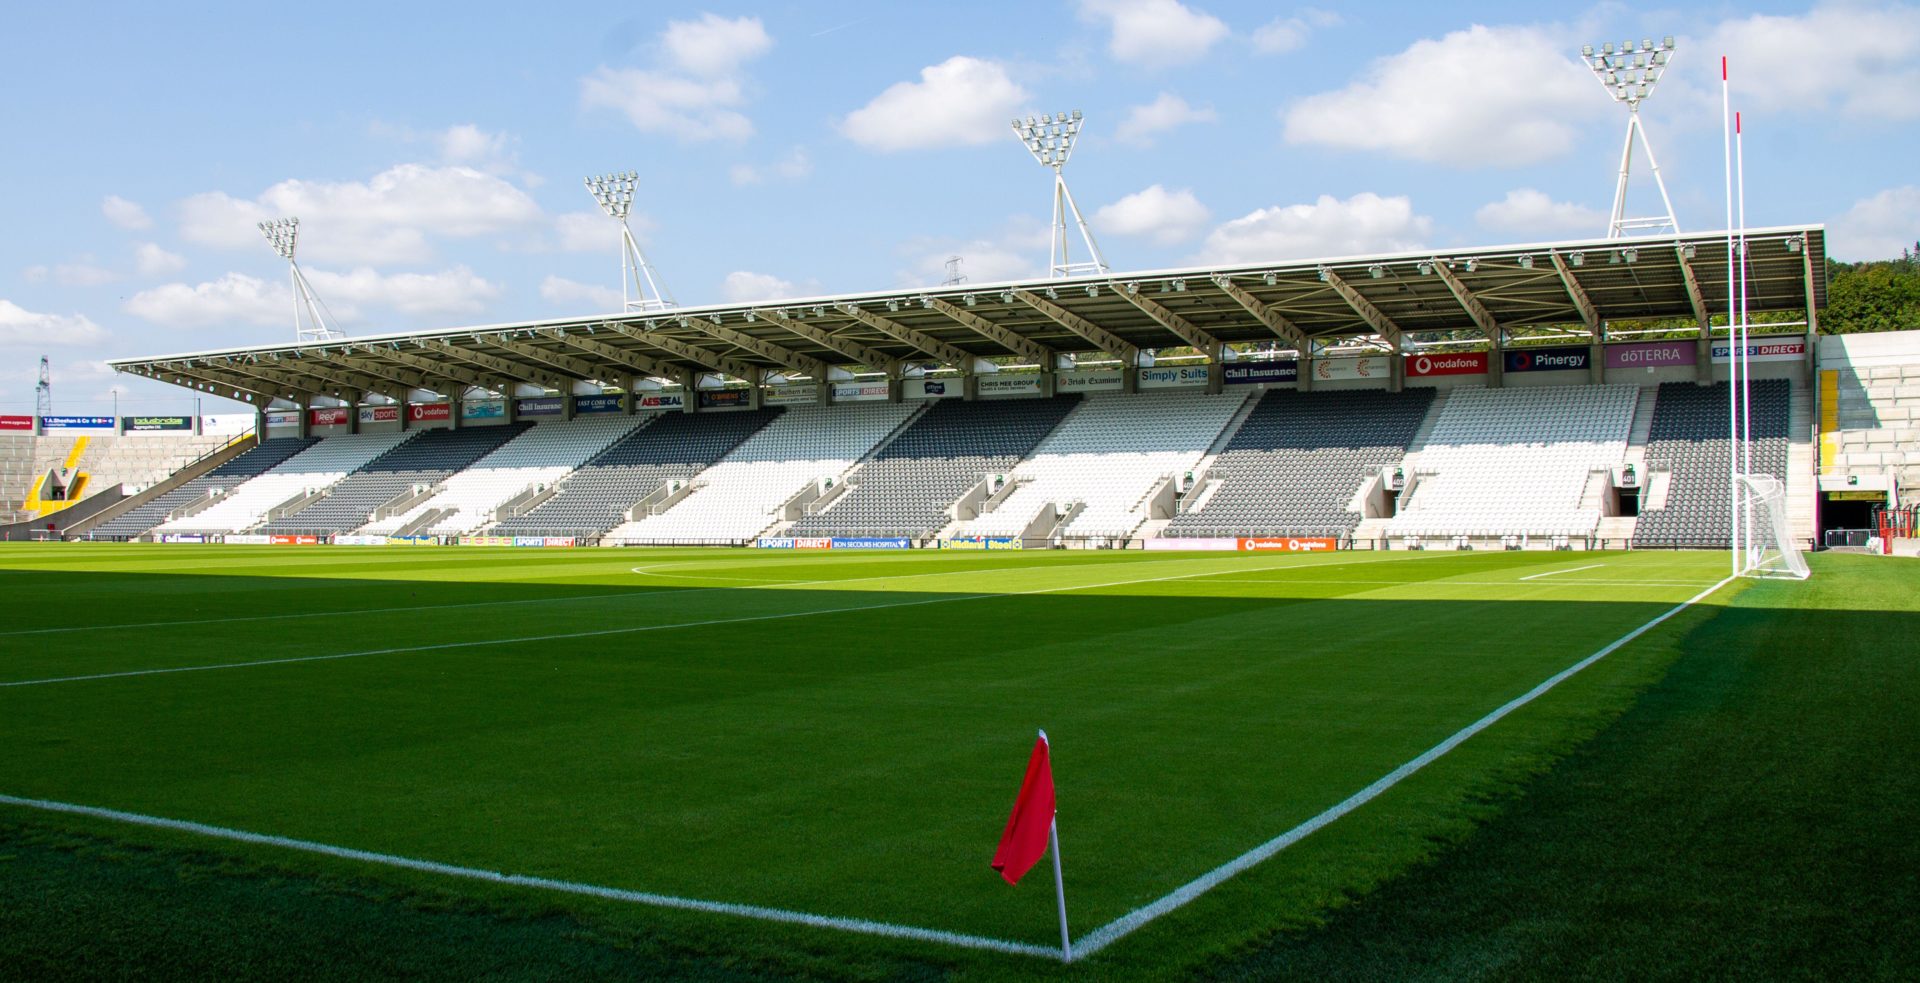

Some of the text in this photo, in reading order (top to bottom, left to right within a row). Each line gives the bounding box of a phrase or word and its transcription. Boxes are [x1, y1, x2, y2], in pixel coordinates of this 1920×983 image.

[1760, 345, 1801, 354] DIRECT
[1433, 358, 1479, 369] vodafone
[1536, 355, 1585, 367] Pinergy
[1142, 368, 1208, 382] Simply Suits
[1225, 368, 1297, 378] Chill Insurance
[1068, 377, 1121, 386] Irish Examiner
[834, 387, 888, 396] SPORTS DIRECT
[641, 396, 683, 407] AESSEAL
[518, 403, 533, 411] Chill
[318, 412, 336, 421] Red
[361, 408, 374, 420] sky
[424, 408, 449, 416] vodafone
[516, 538, 543, 546] SPORTS
[760, 539, 829, 548] SPORTS DIRECT
[872, 540, 898, 548] HOSPITAL
[987, 539, 1012, 549] Steel
